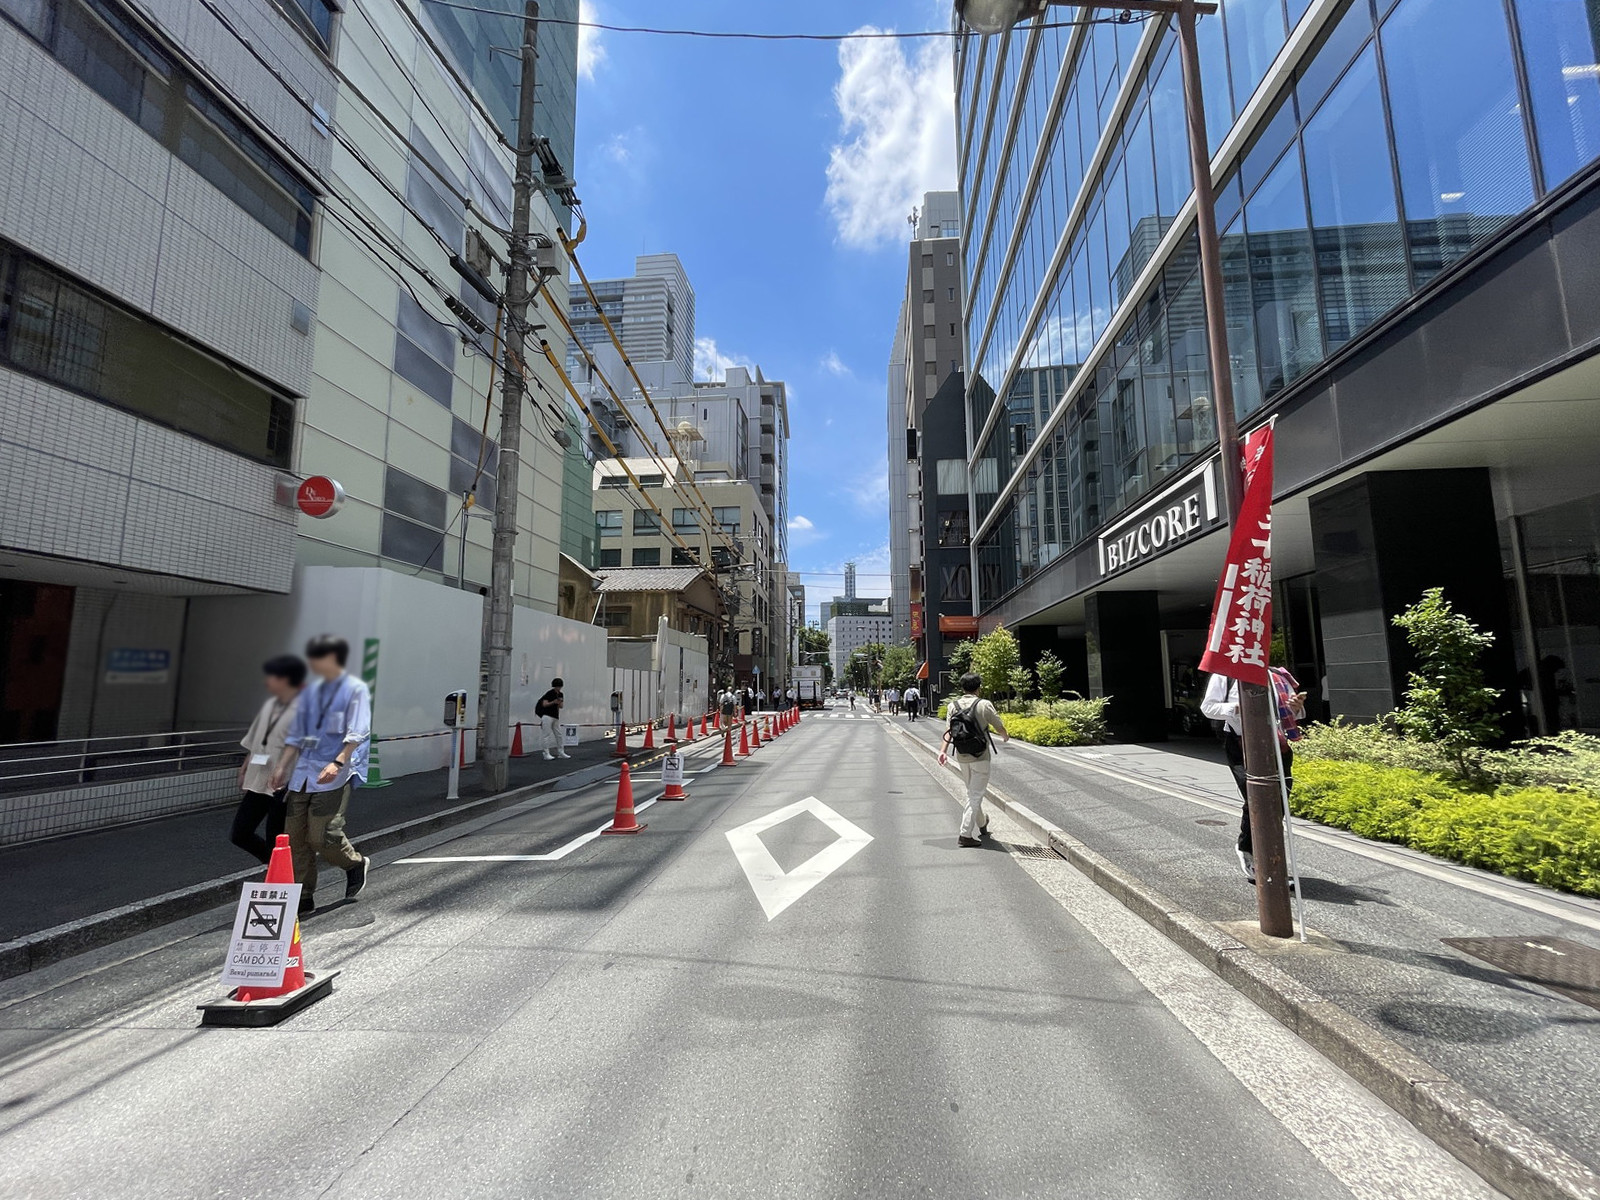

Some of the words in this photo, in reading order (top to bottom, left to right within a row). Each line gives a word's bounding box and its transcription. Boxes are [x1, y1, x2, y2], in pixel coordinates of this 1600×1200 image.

[1107, 493, 1200, 572] BIZCORE
[250, 890, 288, 900] 駐車禁止
[266, 956, 280, 965] XE
